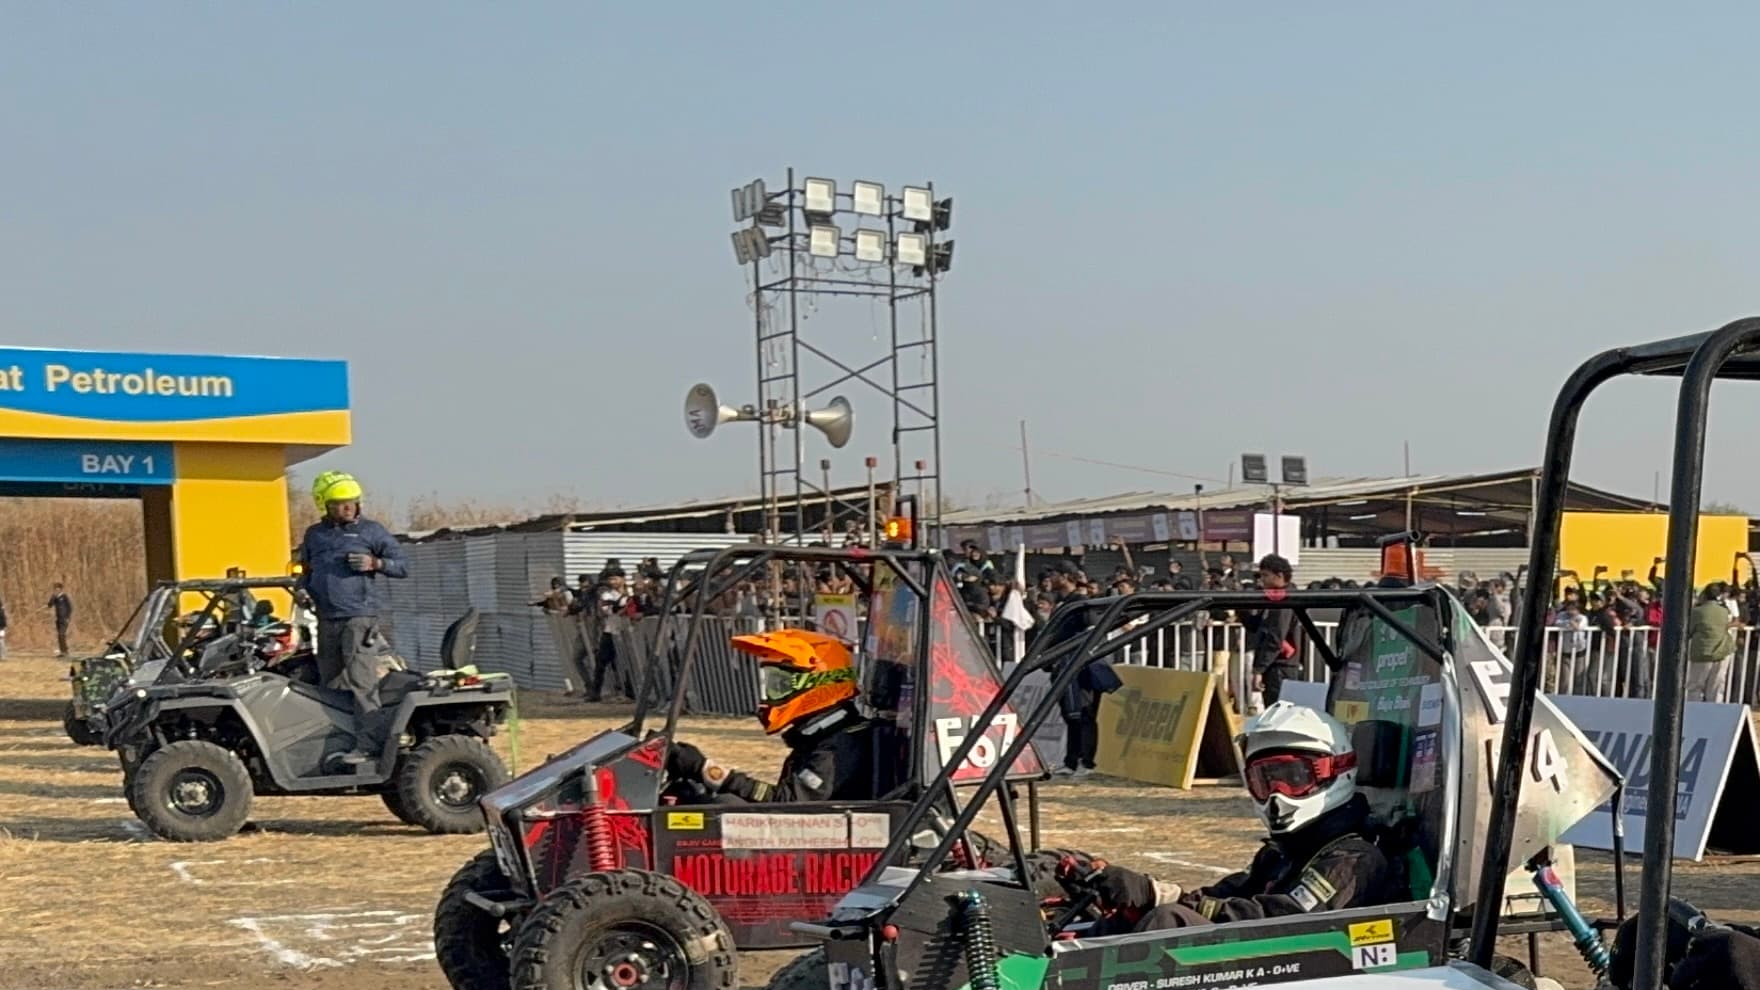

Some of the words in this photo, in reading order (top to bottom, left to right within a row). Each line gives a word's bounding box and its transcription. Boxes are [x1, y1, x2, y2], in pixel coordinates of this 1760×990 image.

[45, 365, 233, 397] Petroleum
[81, 454, 132, 475] BAY
[142, 456, 155, 474] 1
[1116, 689, 1189, 758] Speed
[1156, 974, 1201, 989] SURESH
[1202, 969, 1244, 984] KUMAR
[1246, 968, 1254, 979] K
[1256, 967, 1265, 978] A
